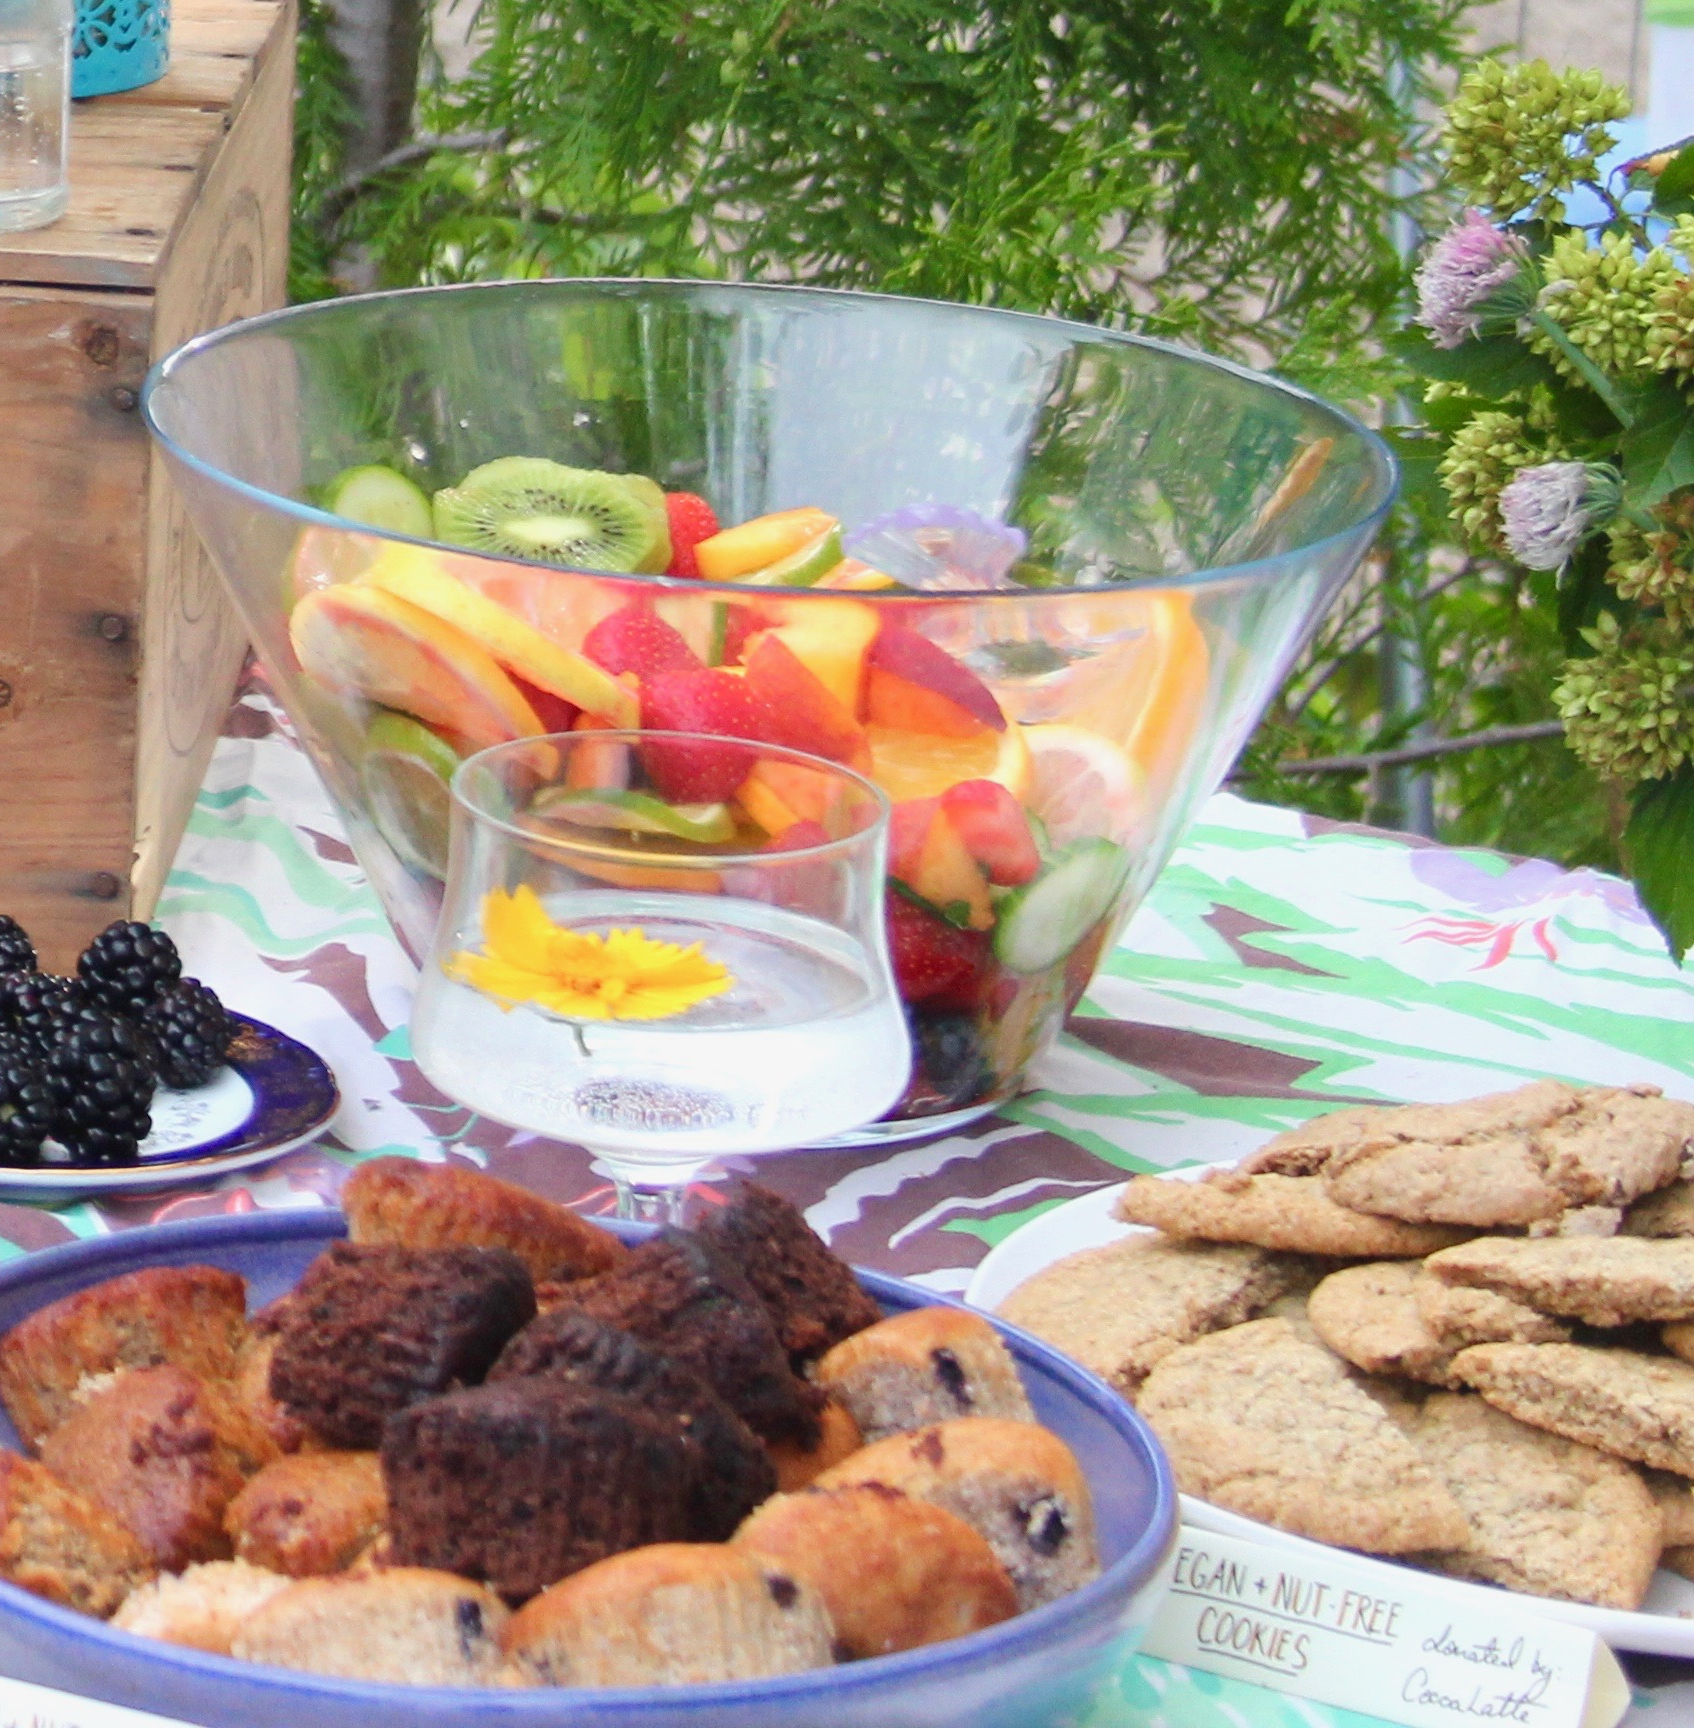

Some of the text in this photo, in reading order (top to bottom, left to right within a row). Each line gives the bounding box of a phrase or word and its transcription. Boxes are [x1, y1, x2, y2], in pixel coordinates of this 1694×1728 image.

[1172, 1547, 1246, 1598] EGAN
[1271, 1571, 1404, 1639] NUT-FREE
[1197, 1606, 1311, 1671] COOKIES
[1421, 1624, 1525, 1669] donated
